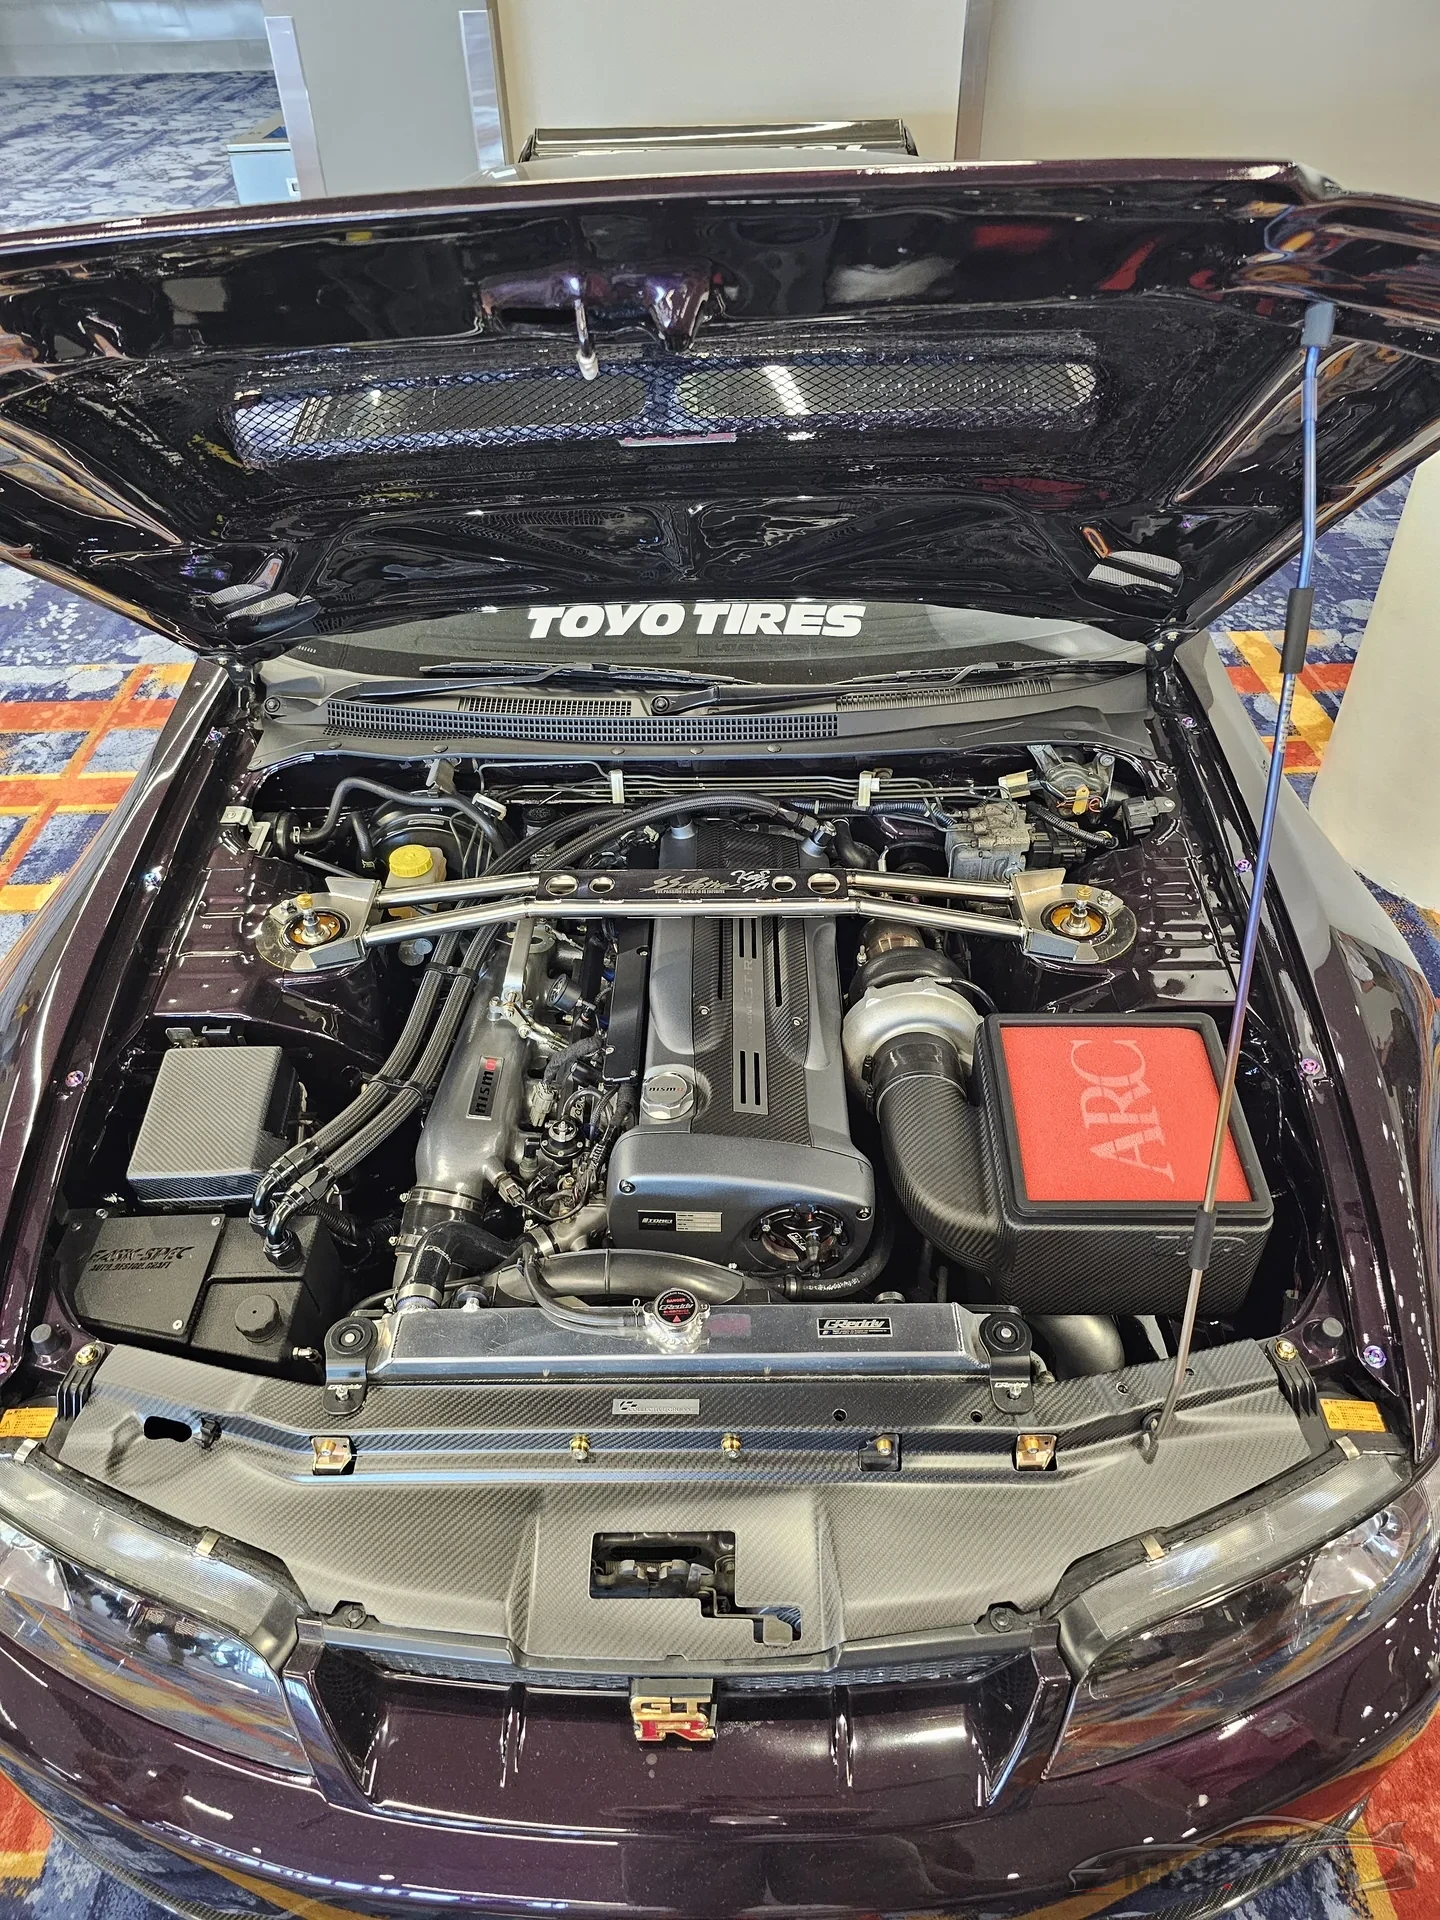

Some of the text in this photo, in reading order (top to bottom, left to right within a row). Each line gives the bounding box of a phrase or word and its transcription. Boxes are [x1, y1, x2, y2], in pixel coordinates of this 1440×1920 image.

[527, 602, 866, 639] TOYO TIRES
[475, 1058, 497, 1114] nismo
[1070, 1039, 1175, 1183] ARC
[823, 1319, 885, 1329] GReddy
